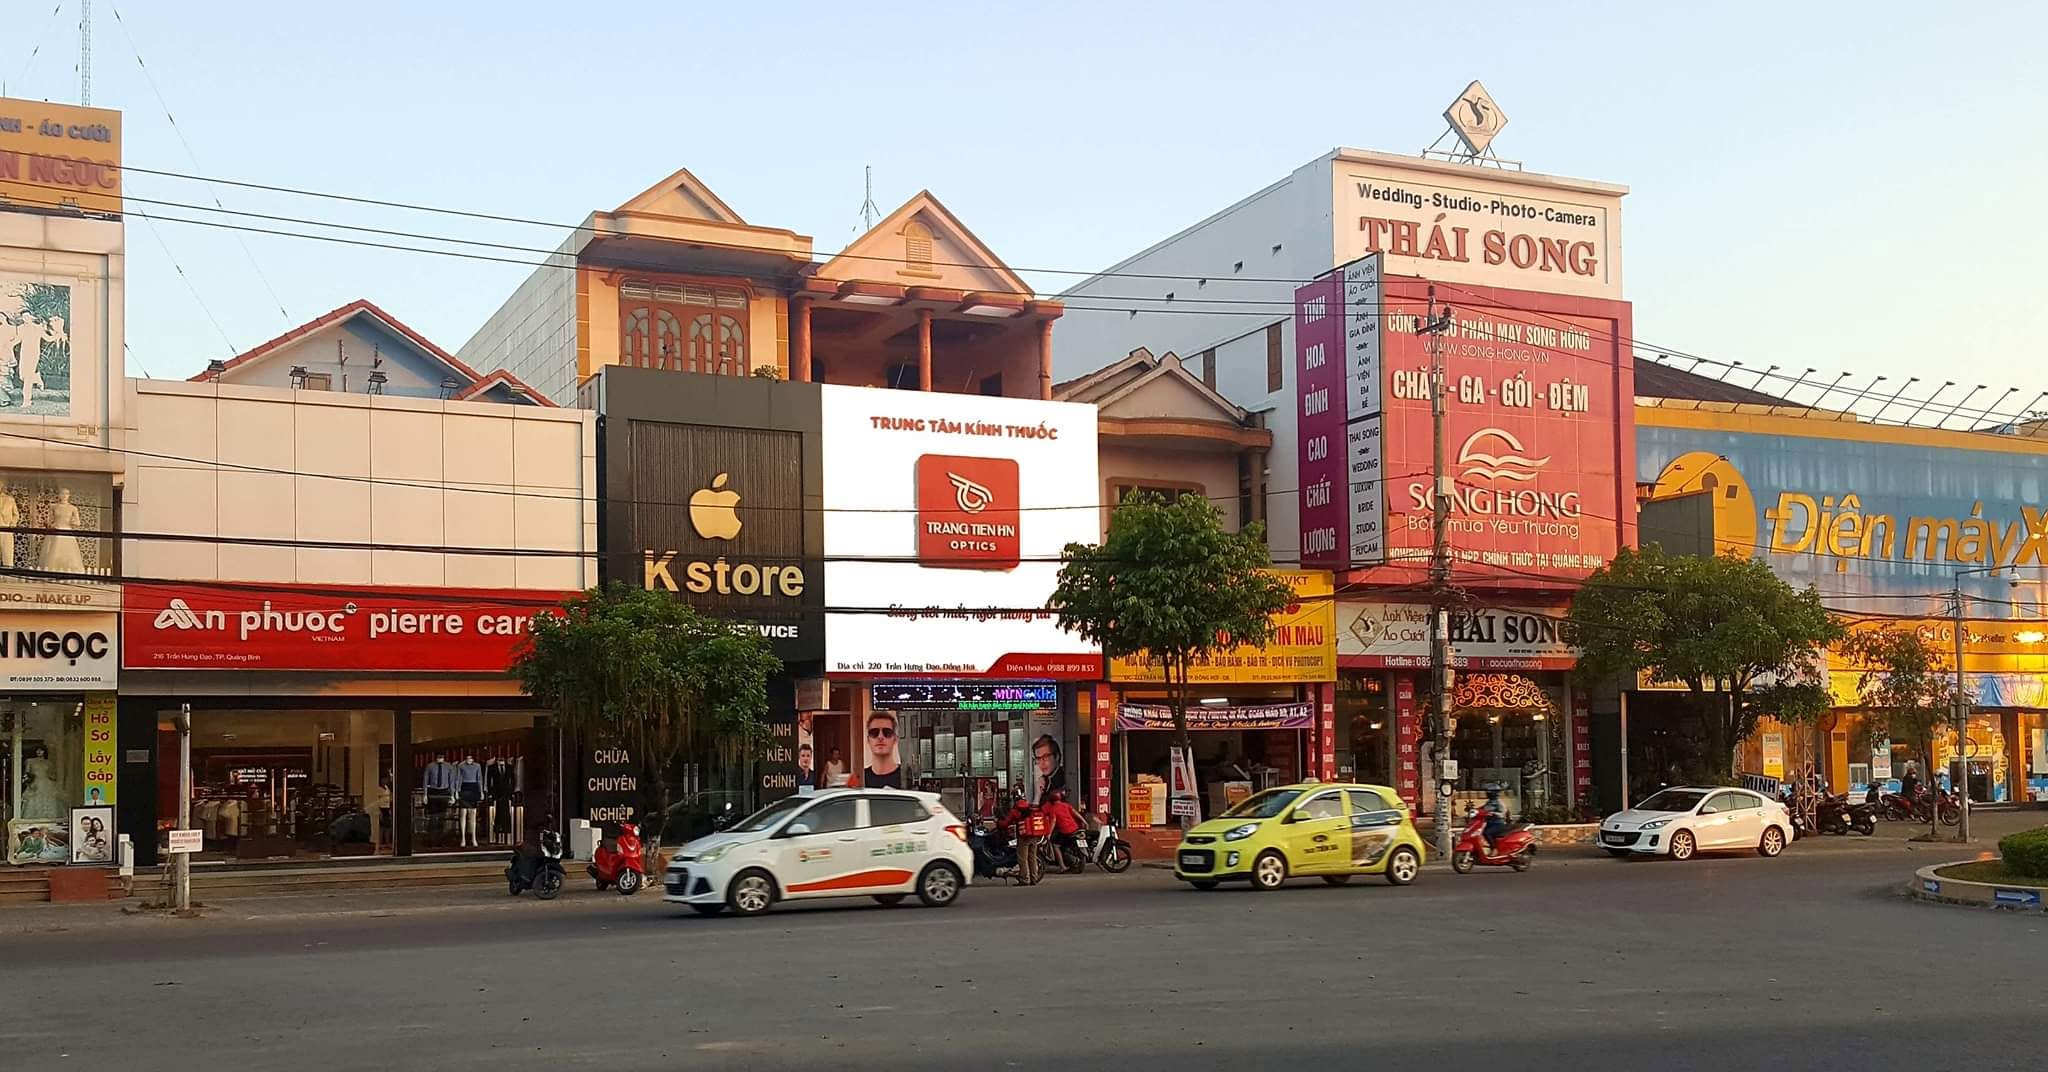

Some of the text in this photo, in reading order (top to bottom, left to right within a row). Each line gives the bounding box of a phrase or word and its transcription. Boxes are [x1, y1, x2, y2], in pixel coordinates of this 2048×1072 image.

[1357, 182, 1596, 226] Wedding Studio Photo Camera
[1360, 212, 1598, 277] THÁI SONG
[1462, 314, 1493, 341] PHẦN
[1497, 325, 1523, 345] MAY
[1306, 343, 1326, 370] HOA
[1460, 375, 1486, 404] GA
[1502, 369, 1534, 408] GỐI
[1550, 377, 1589, 417] ĐỆM
[870, 416, 1058, 440] TRUNG TÂM KÍNH THUỐC
[1307, 435, 1328, 462] CAO
[1306, 474, 1331, 508] CHẤT
[1357, 500, 1374, 513] BRIDE
[926, 521, 968, 536] TRANG
[998, 523, 1015, 537] HN
[1356, 521, 1376, 535] STUDIO
[1448, 516, 1484, 533] mùa
[1489, 518, 1518, 534] Yêu
[1522, 519, 1580, 539] Thương
[1765, 490, 1896, 574] Điện
[950, 540, 997, 551] OPTICS
[1304, 527, 1336, 557] LƯỢNG
[1483, 551, 1509, 567] CHÍNH
[1511, 551, 1534, 568] THỨC
[1536, 552, 1550, 570] TẠI
[1552, 550, 1580, 568] QUẢNG
[1583, 550, 1603, 568] BÌNH
[645, 550, 804, 596] K store
[36, 593, 72, 604] MAKE
[75, 595, 91, 604] UP
[240, 600, 345, 640] phuoc
[370, 609, 464, 638] pierre
[1383, 604, 1425, 624] Ảnh Viện
[1295, 621, 1324, 646] MÀU
[16, 630, 108, 666] NGỌC
[868, 662, 882, 670] 220
[1385, 656, 1415, 667] Hotline:
[90, 710, 109, 724] Hồ
[91, 730, 110, 741] Sơ
[766, 723, 791, 737] INH
[594, 747, 630, 764] CHỮA
[767, 747, 792, 764] KIỆN
[87, 768, 113, 783] Gấp
[588, 774, 636, 791] CHUYÊN
[763, 772, 796, 788] CHÍNH
[1744, 774, 1776, 793] MINH
[590, 804, 634, 824] NGHIỆP
